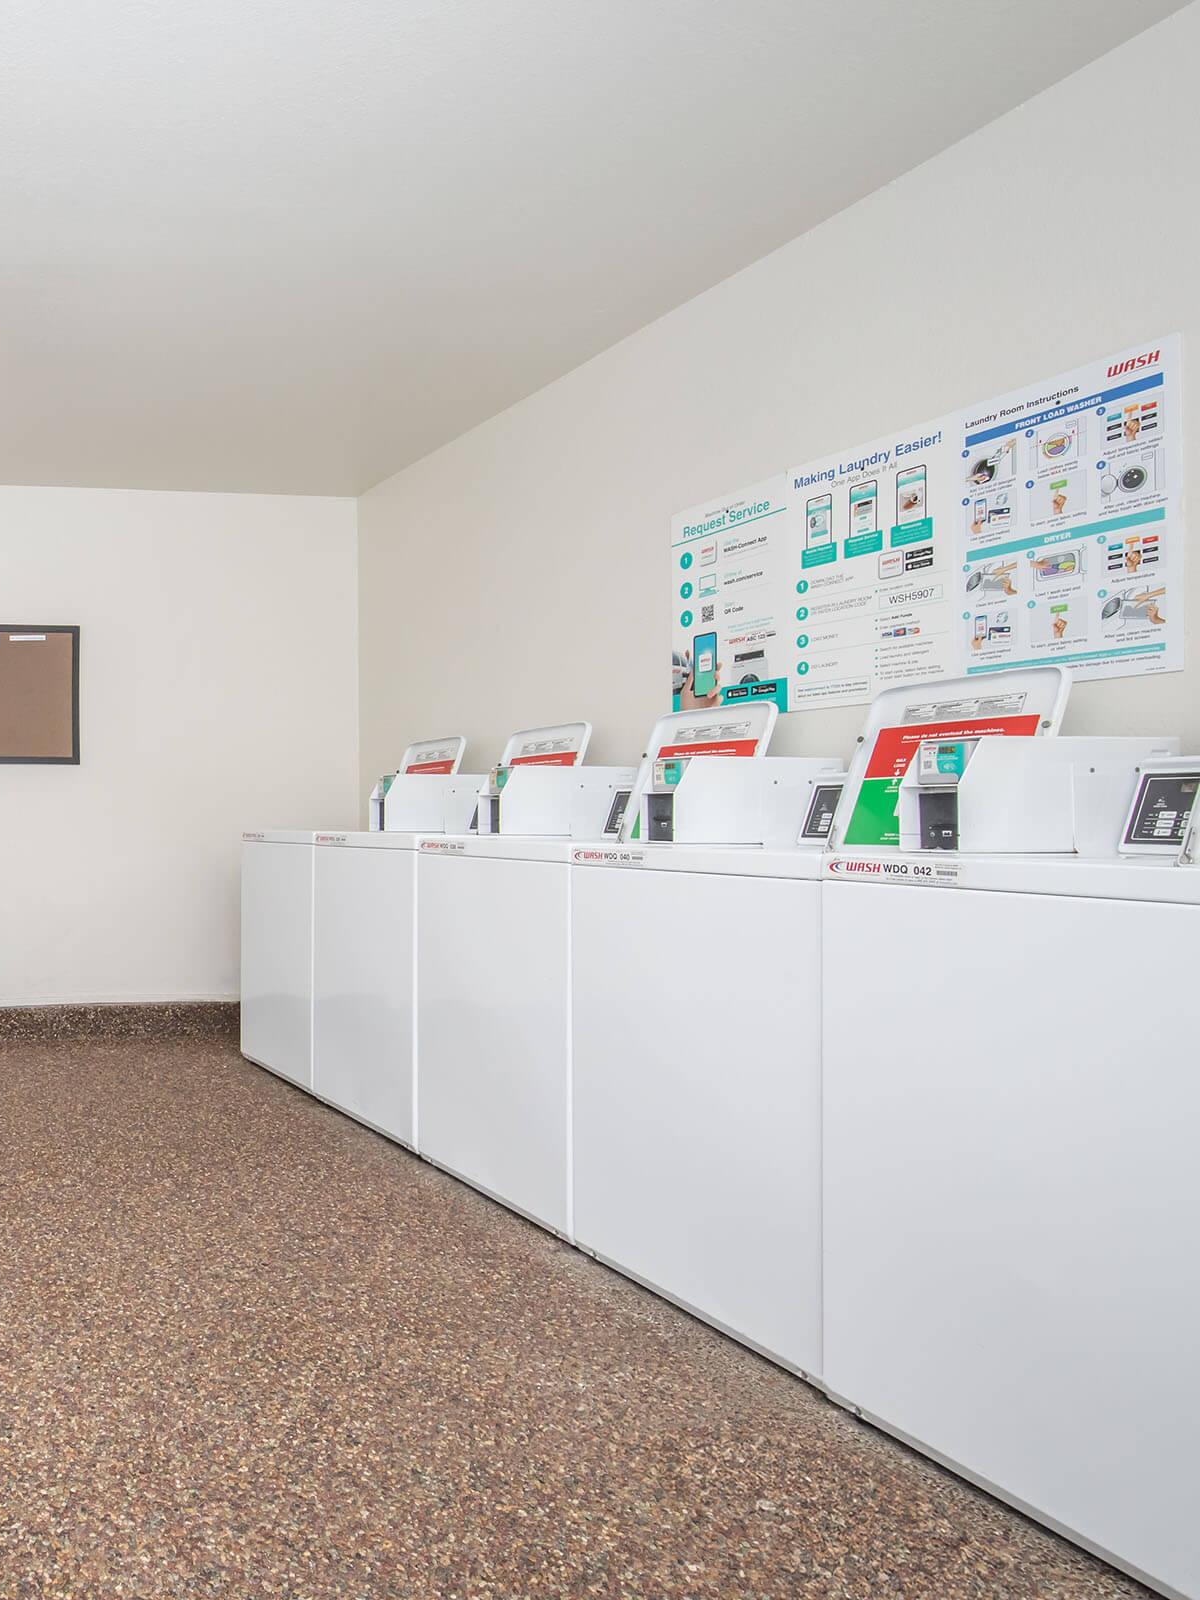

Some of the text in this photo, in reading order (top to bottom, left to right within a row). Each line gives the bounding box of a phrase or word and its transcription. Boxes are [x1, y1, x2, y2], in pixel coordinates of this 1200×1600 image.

[1107, 350, 1161, 378] WASH
[965, 385, 1079, 429] Laundry Room Instructions
[1015, 397, 1102, 430] FRONT LOAD WASHER
[794, 431, 942, 489] Making Laundry Easier!
[831, 478, 844, 488] One
[847, 472, 861, 485] App
[862, 468, 882, 480] Does
[683, 514, 726, 538] Request
[729, 500, 770, 523] Service
[1044, 532, 1072, 543] DRYER
[888, 587, 935, 605] WSH5907
[902, 733, 920, 741] Please
[939, 729, 963, 737] overload
[974, 726, 1006, 735] machines.
[583, 851, 603, 861] WASH
[620, 853, 630, 861] 040
[846, 861, 932, 876] WASH WDQ 042
